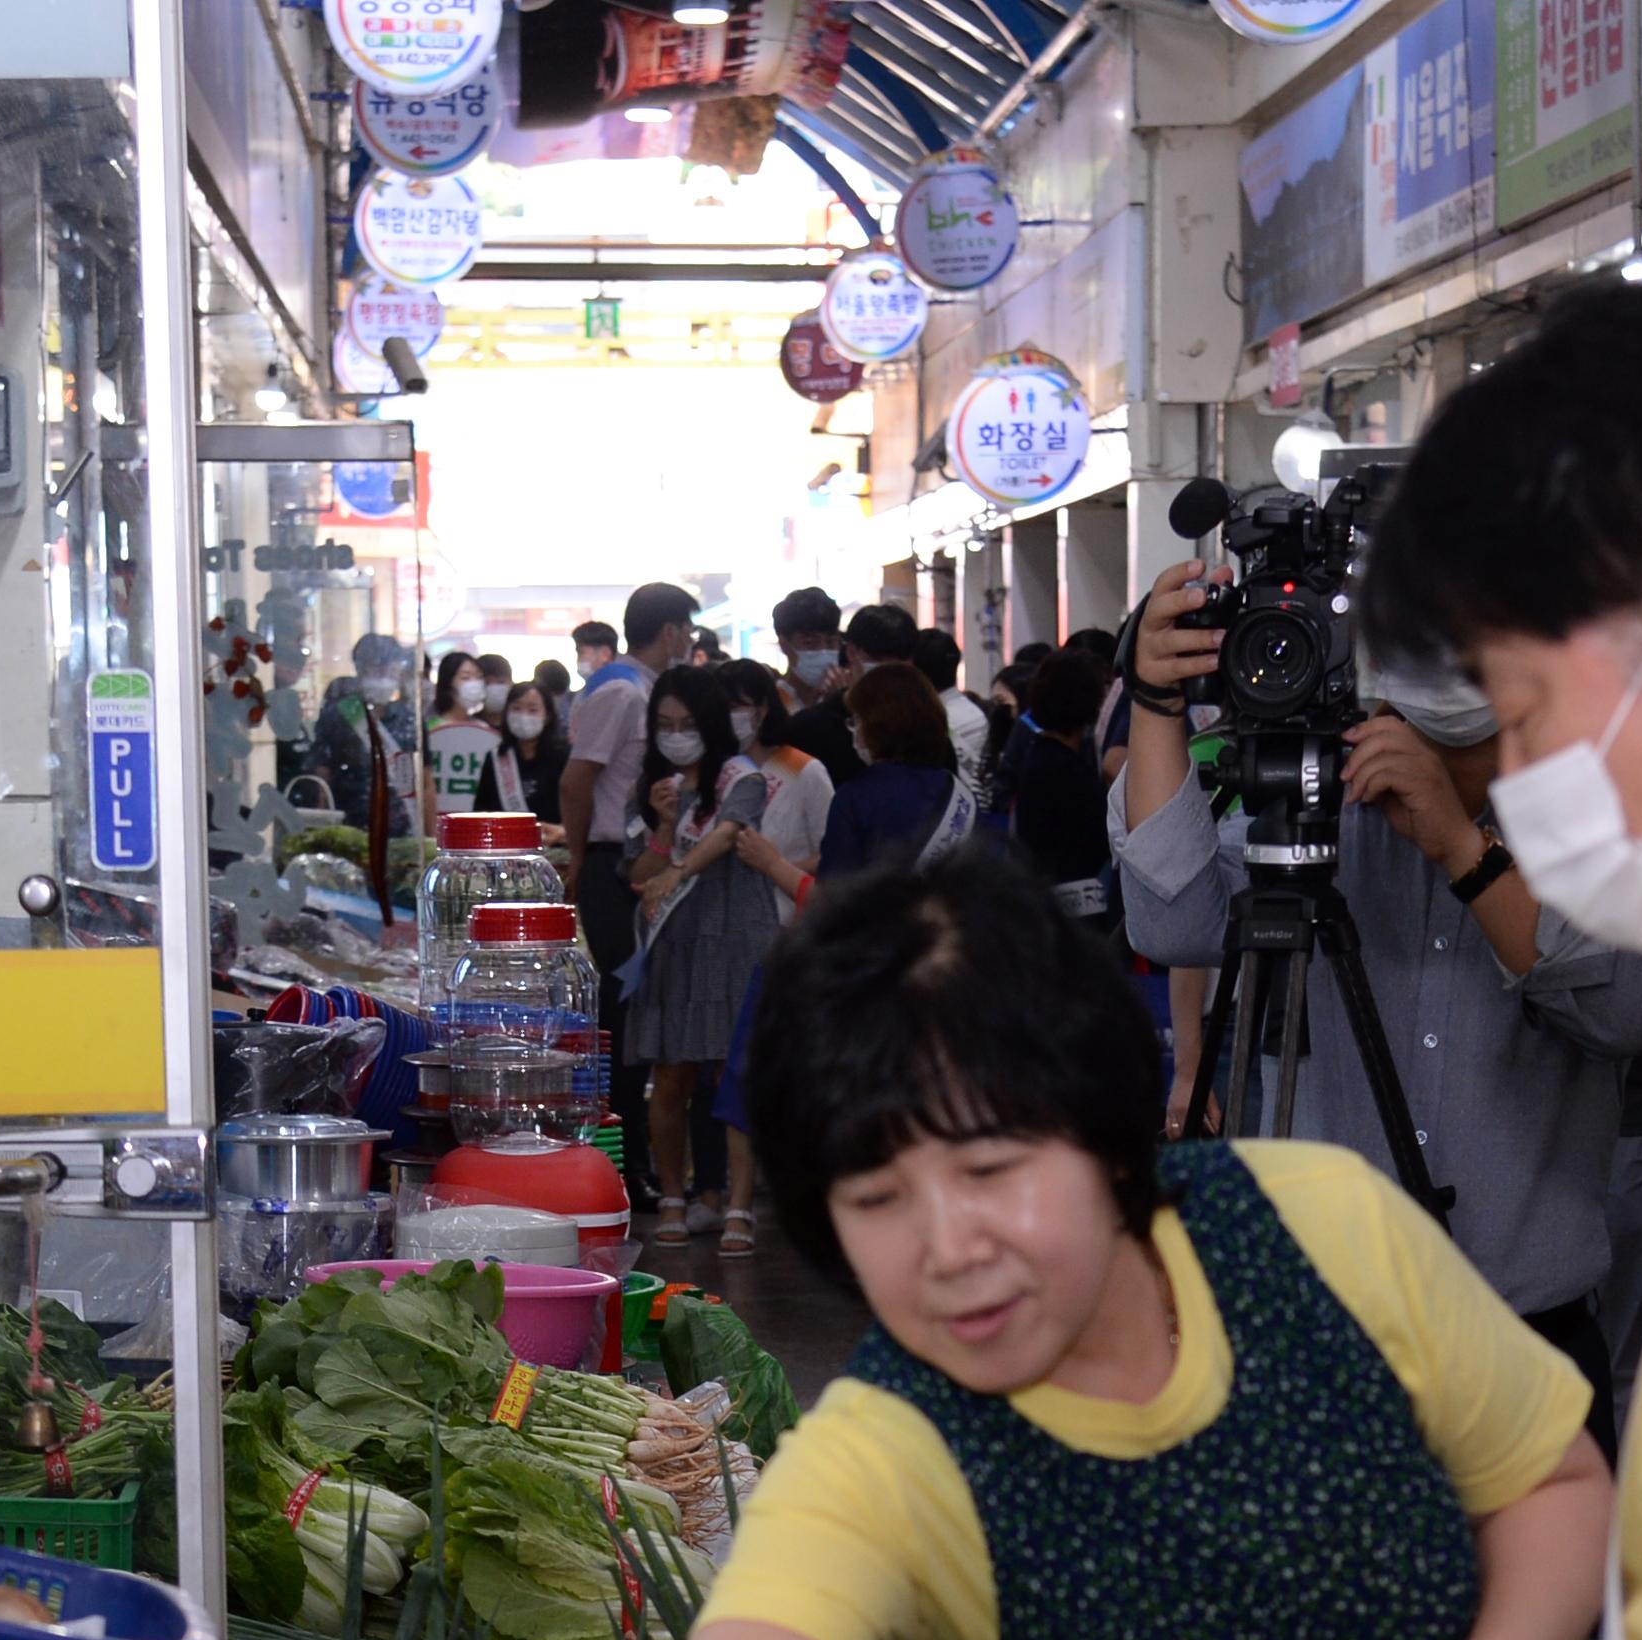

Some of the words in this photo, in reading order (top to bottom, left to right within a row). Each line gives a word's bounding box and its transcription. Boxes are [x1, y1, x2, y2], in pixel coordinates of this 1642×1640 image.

[978, 420, 1068, 451] 화장실
[998, 456, 1047, 470] TOILET
[109, 738, 134, 858] PULL
